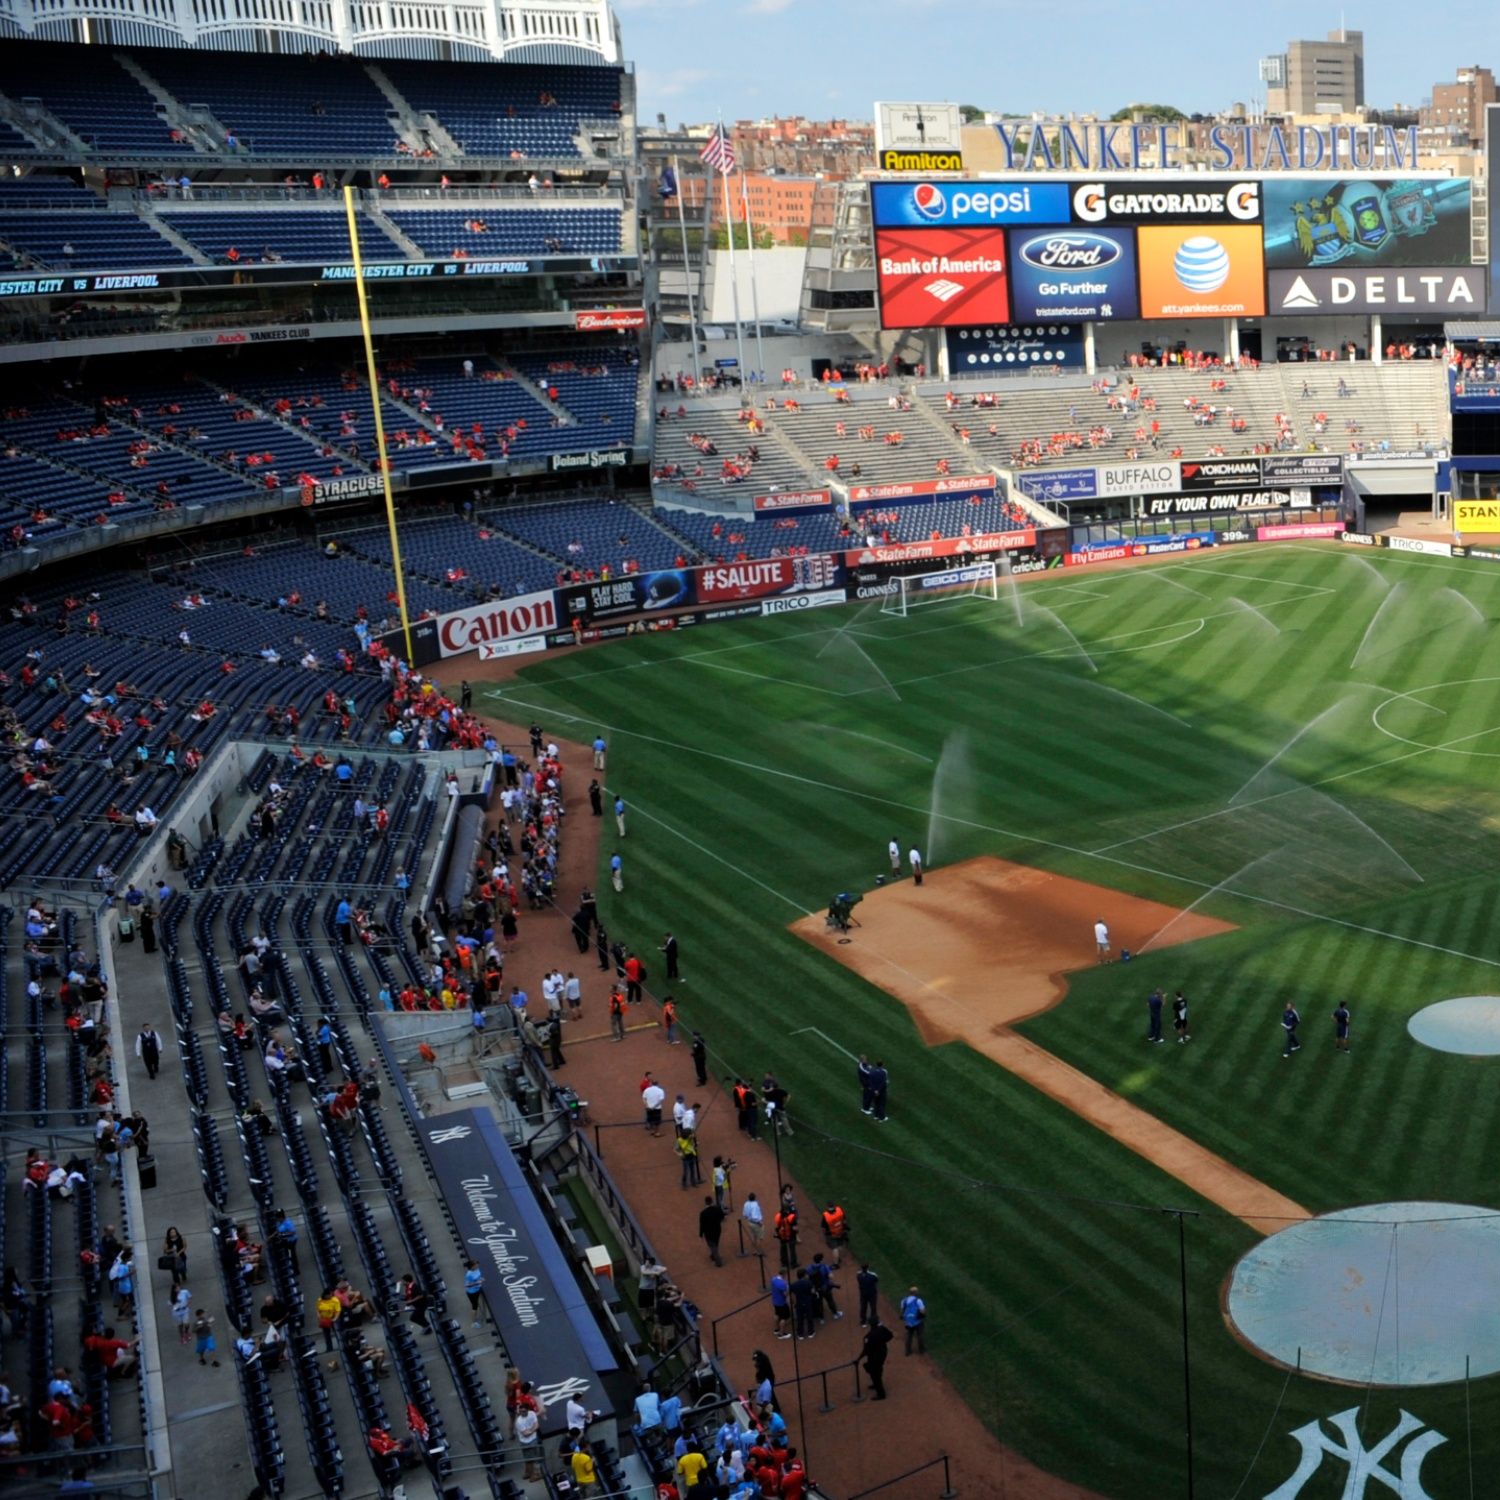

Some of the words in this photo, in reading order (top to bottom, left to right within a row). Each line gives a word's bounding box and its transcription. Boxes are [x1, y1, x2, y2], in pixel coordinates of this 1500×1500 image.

[993, 123, 1181, 169] YANKEE
[1210, 124, 1420, 170] STADIUM
[885, 151, 961, 169] Armitron
[952, 187, 1031, 219] pepsi
[1108, 195, 1224, 214] GATORADE
[1040, 238, 1102, 265] Ford
[406, 264, 434, 276] CITY
[463, 262, 528, 274] LIVERPOOL
[881, 258, 921, 274] Bank
[922, 257, 938, 273] of
[939, 256, 1002, 273] America
[38, 279, 64, 293] CITY
[94, 275, 159, 290] LIVERPOOL
[1039, 283, 1058, 296] Go
[1060, 282, 1108, 295] Further
[1331, 276, 1474, 304] DELTA
[1036, 306, 1096, 317] tristateford.com
[1161, 302, 1244, 314] att.yankees.com
[577, 314, 643, 328] Budweiser
[249, 330, 288, 341] YANKEES
[288, 328, 310, 339] CLUB
[552, 454, 590, 470] Poland
[590, 450, 627, 468] Spring
[1106, 467, 1172, 485] BUFFALO
[1200, 463, 1258, 476] YOKOHAMA
[1274, 467, 1330, 475] COLLECTIBLES
[315, 476, 384, 498] SYRACUSE
[1150, 498, 1173, 513] FLY
[1175, 497, 1207, 511] YOUR
[1210, 495, 1239, 509] OWN
[1240, 492, 1269, 506] FLAG
[1341, 531, 1373, 544] GUINNESS
[1392, 538, 1424, 550] TRICO
[1072, 553, 1087, 566] Fly
[1088, 548, 1125, 561] Emirates
[1148, 542, 1185, 554] MasterCard
[1012, 558, 1046, 574] cricket
[702, 562, 783, 590] #SALUTE
[922, 572, 959, 588] GEICO
[960, 565, 994, 582] GEICO
[591, 586, 611, 598] PLAY
[856, 582, 898, 598] GUINNESS
[594, 595, 611, 608] STAY
[764, 597, 810, 612] TRICO
[440, 600, 554, 652] Canon
[460, 1174, 498, 1223] Welcome
[480, 1221, 505, 1234] to
[467, 1228, 528, 1274] Yankee
[502, 1276, 544, 1328] Stadium
